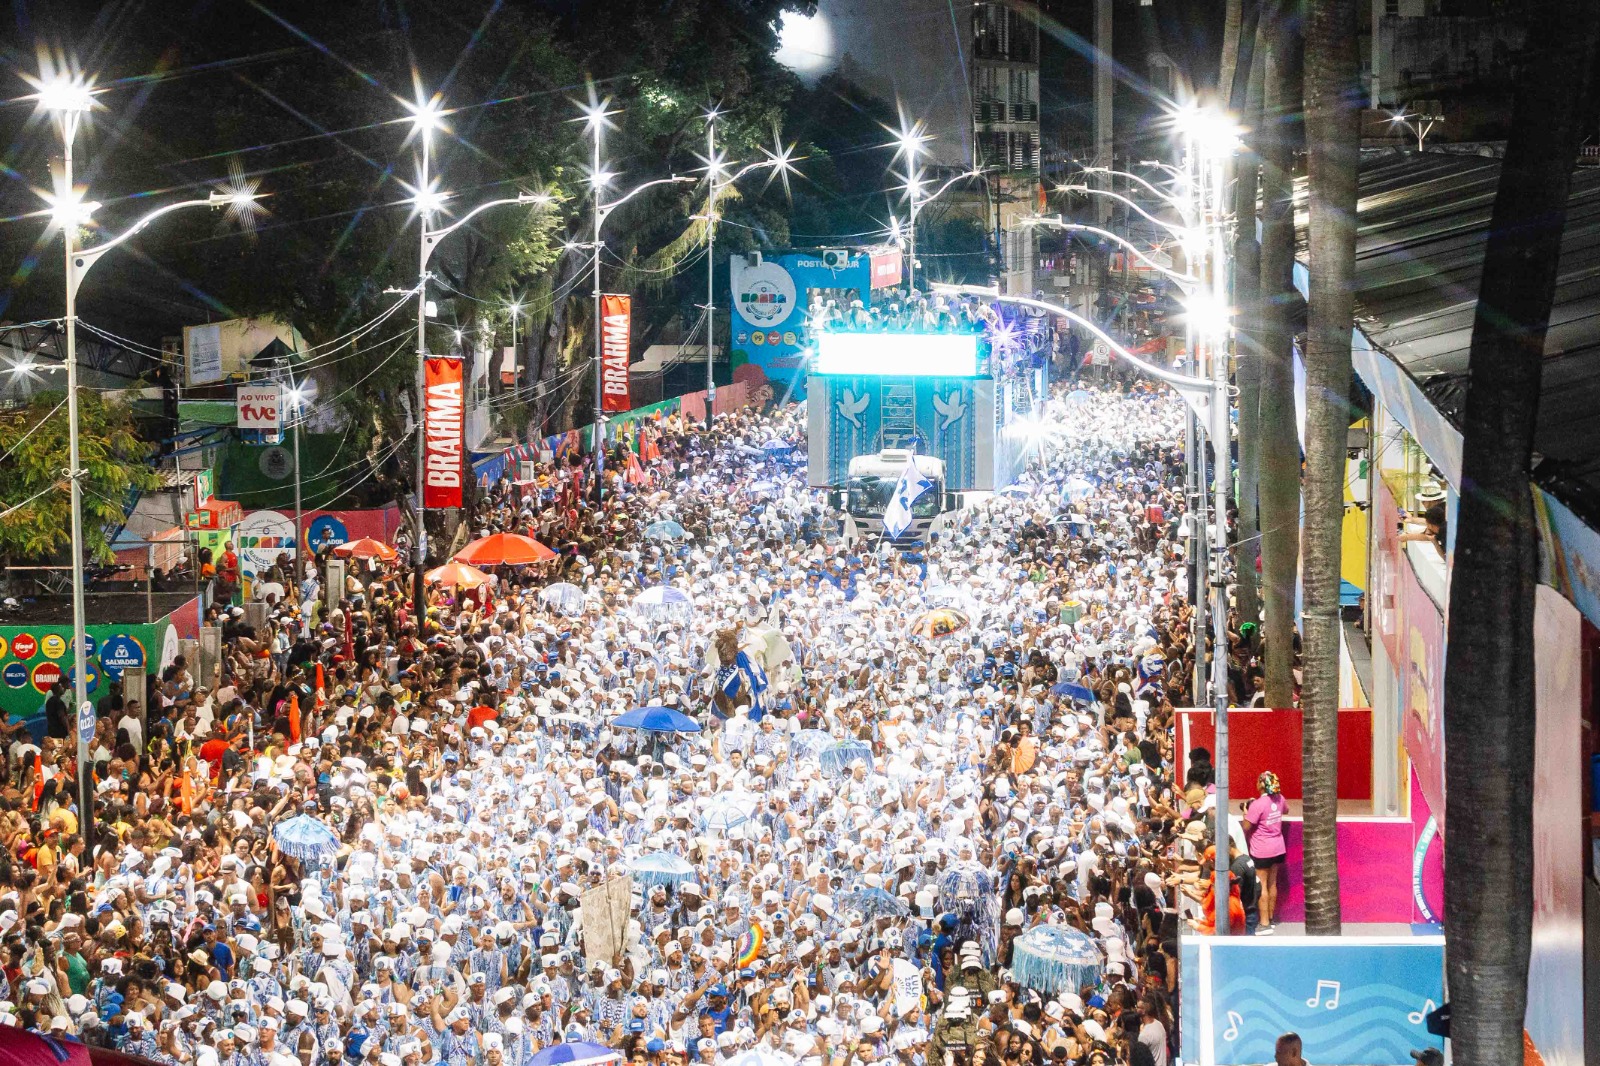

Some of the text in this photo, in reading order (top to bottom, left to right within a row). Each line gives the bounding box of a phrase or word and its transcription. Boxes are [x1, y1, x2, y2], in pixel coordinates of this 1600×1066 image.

[603, 314, 628, 396] BRAHMA
[240, 403, 276, 421] tve
[427, 382, 461, 488] BRAHMA
[105, 658, 139, 666] SALVADOR
[911, 974, 919, 998] LULA
